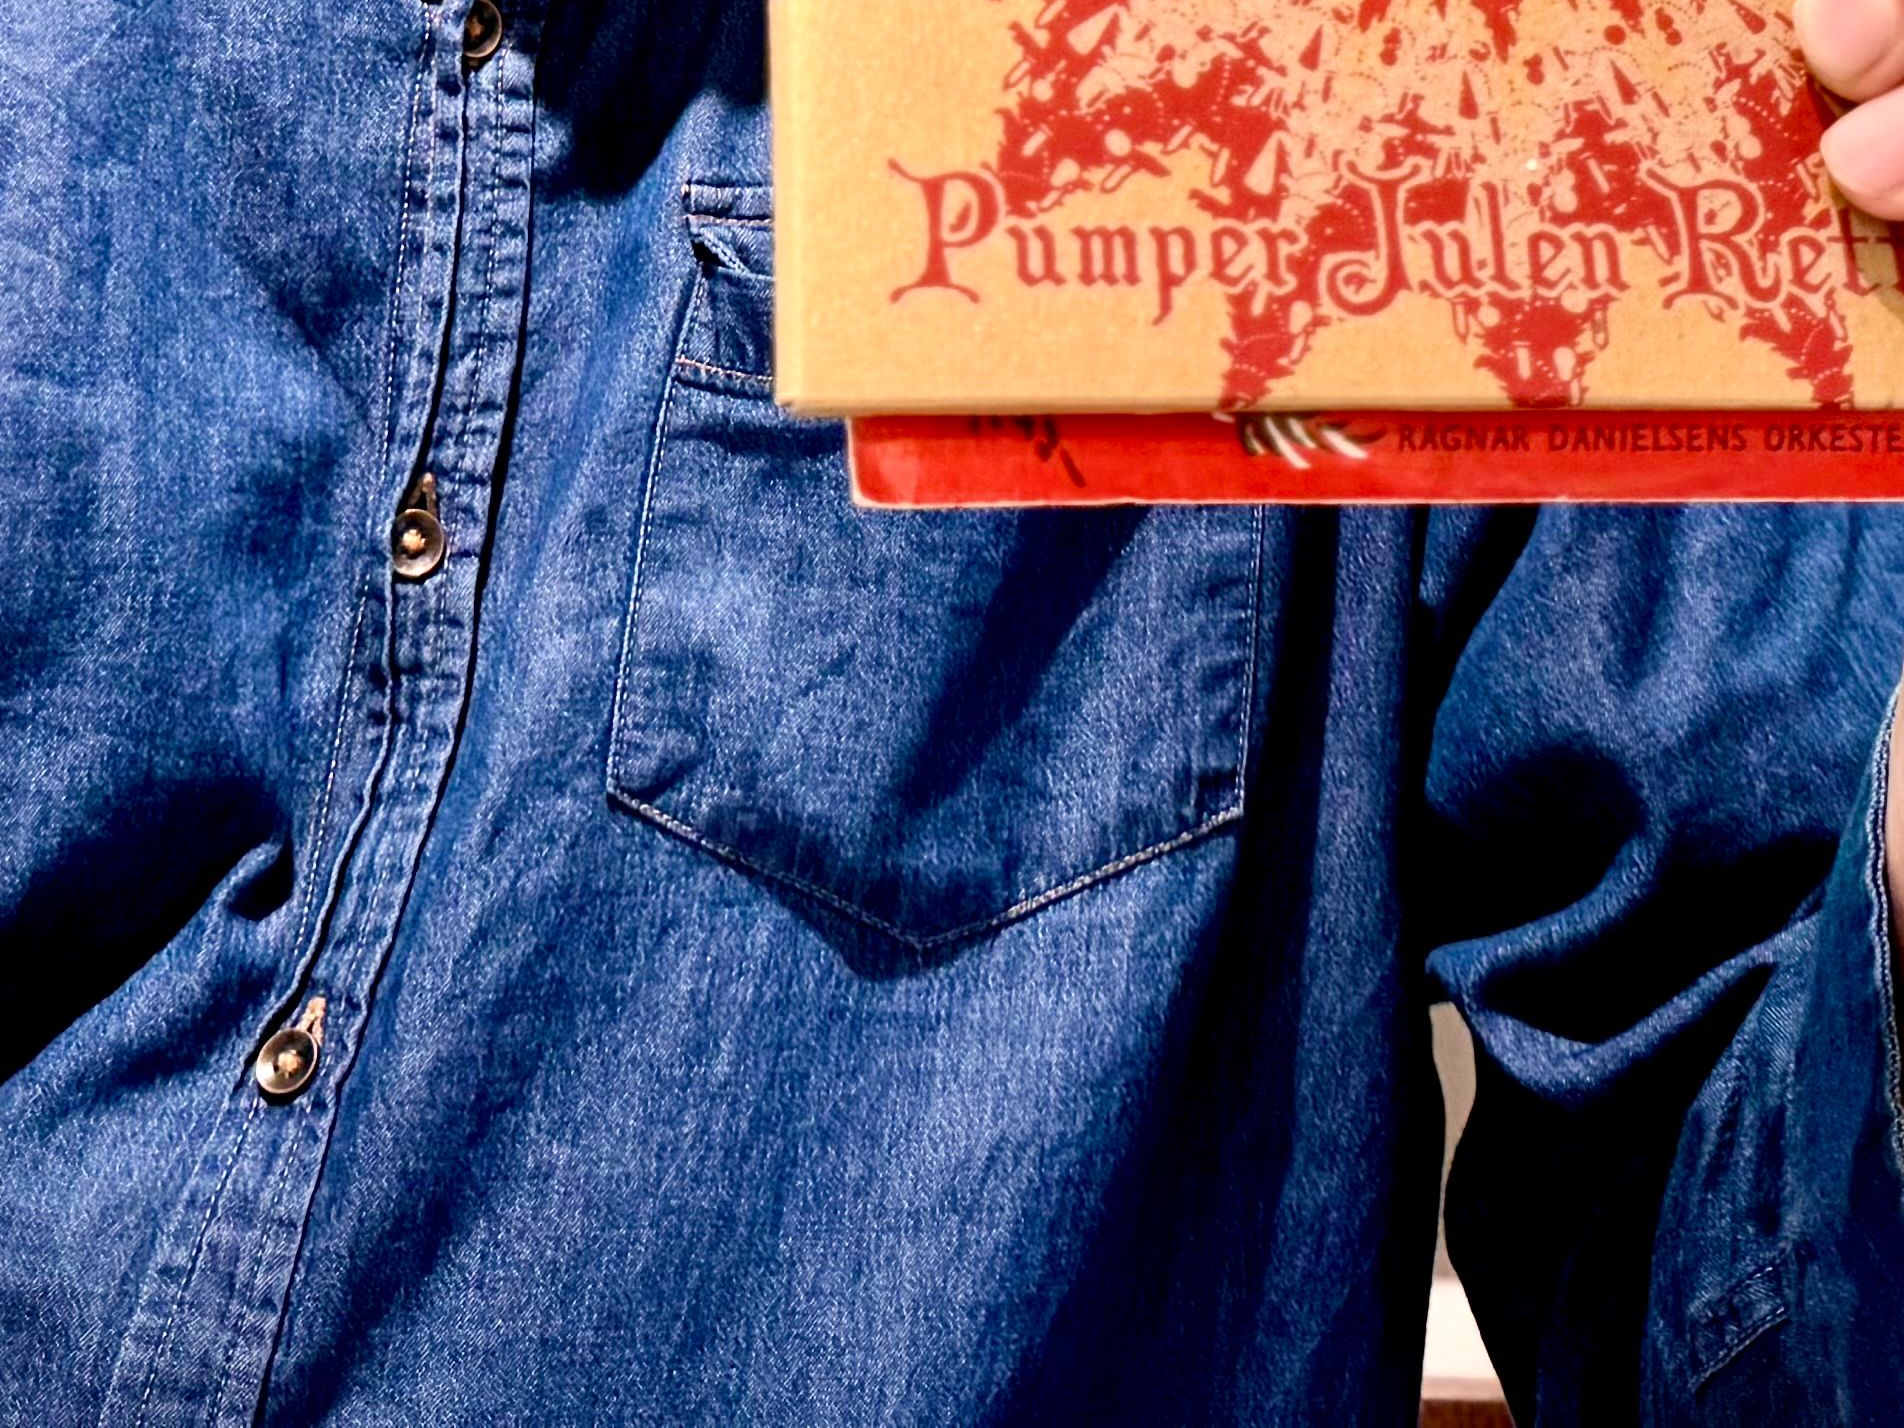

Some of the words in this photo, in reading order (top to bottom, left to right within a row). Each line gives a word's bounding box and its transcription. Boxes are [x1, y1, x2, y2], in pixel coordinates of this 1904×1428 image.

[889, 157, 1297, 328] Pumper
[1325, 157, 1631, 316] Julen
[1397, 420, 1532, 454] RAGNAR
[1548, 421, 1749, 455] DANIELSENS
